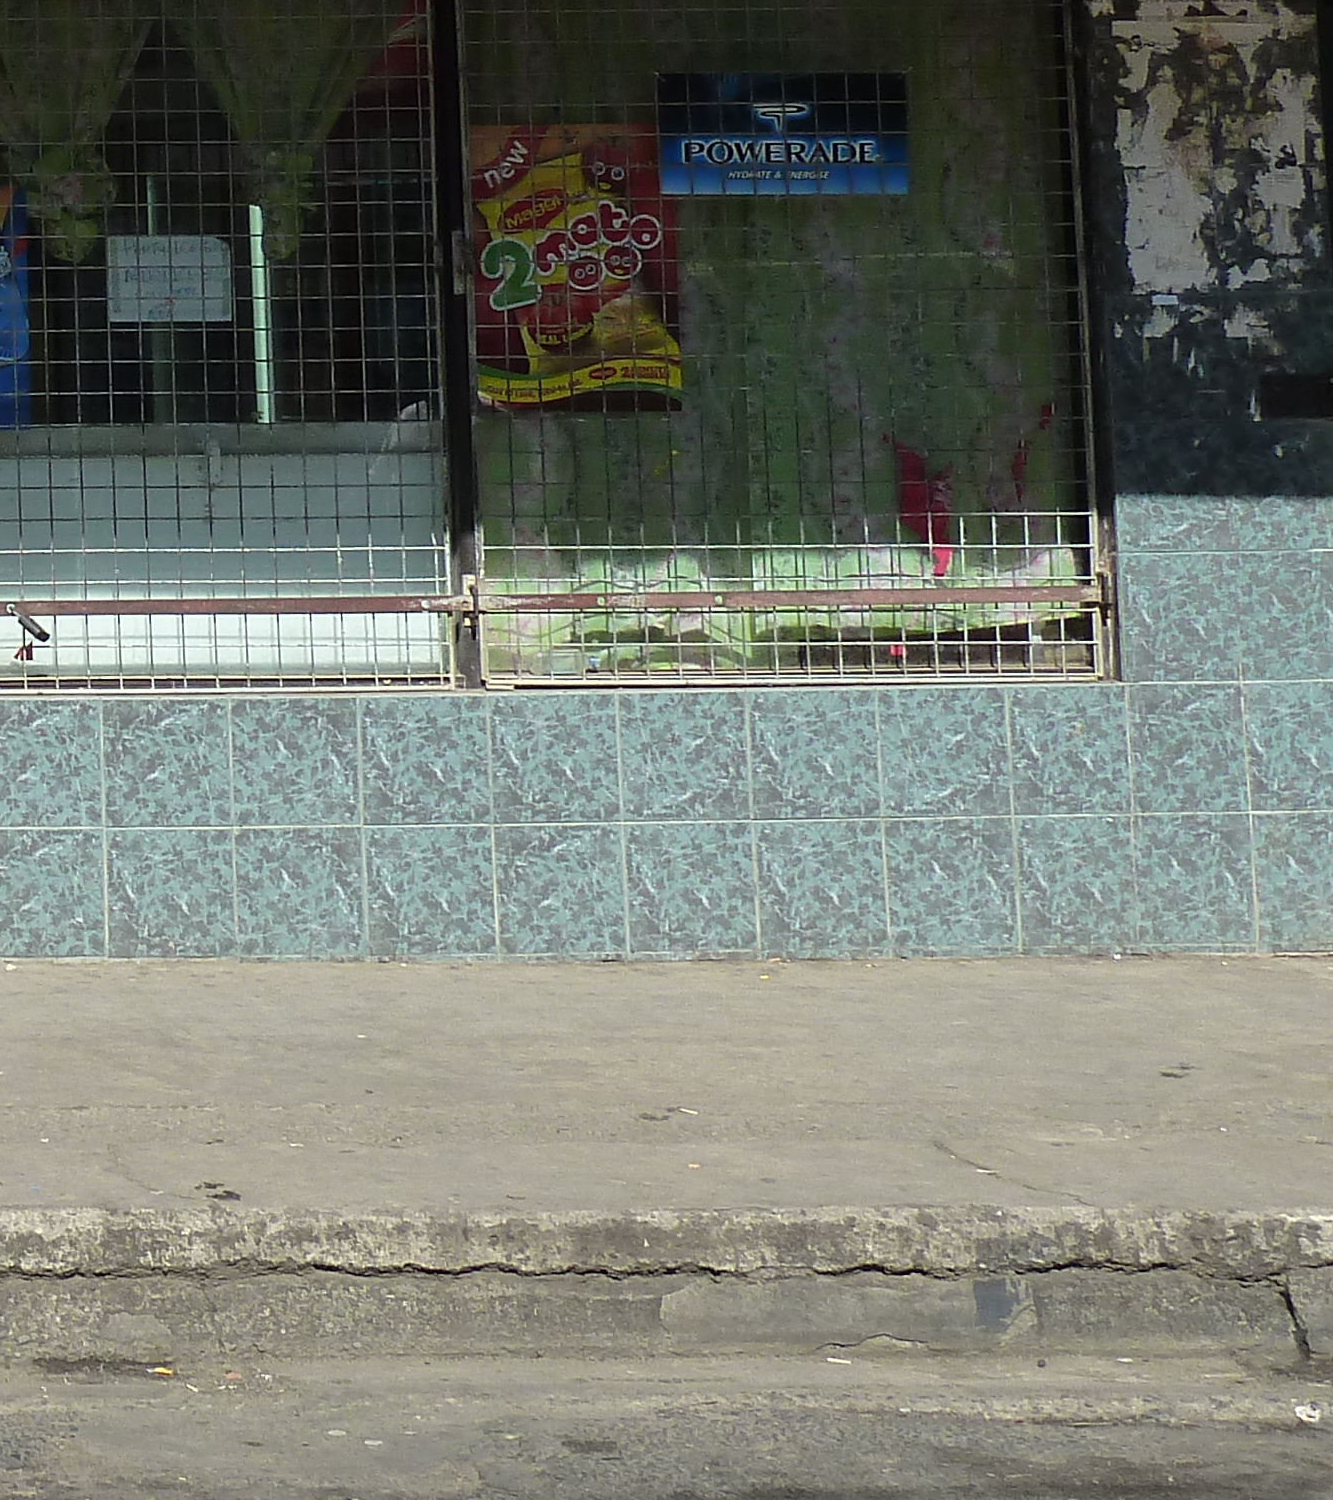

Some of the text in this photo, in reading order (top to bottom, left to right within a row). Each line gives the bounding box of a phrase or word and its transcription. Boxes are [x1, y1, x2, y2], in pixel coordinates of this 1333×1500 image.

[483, 140, 529, 190] new
[682, 140, 876, 165] POWERADE
[785, 170, 830, 181] NERGSE
